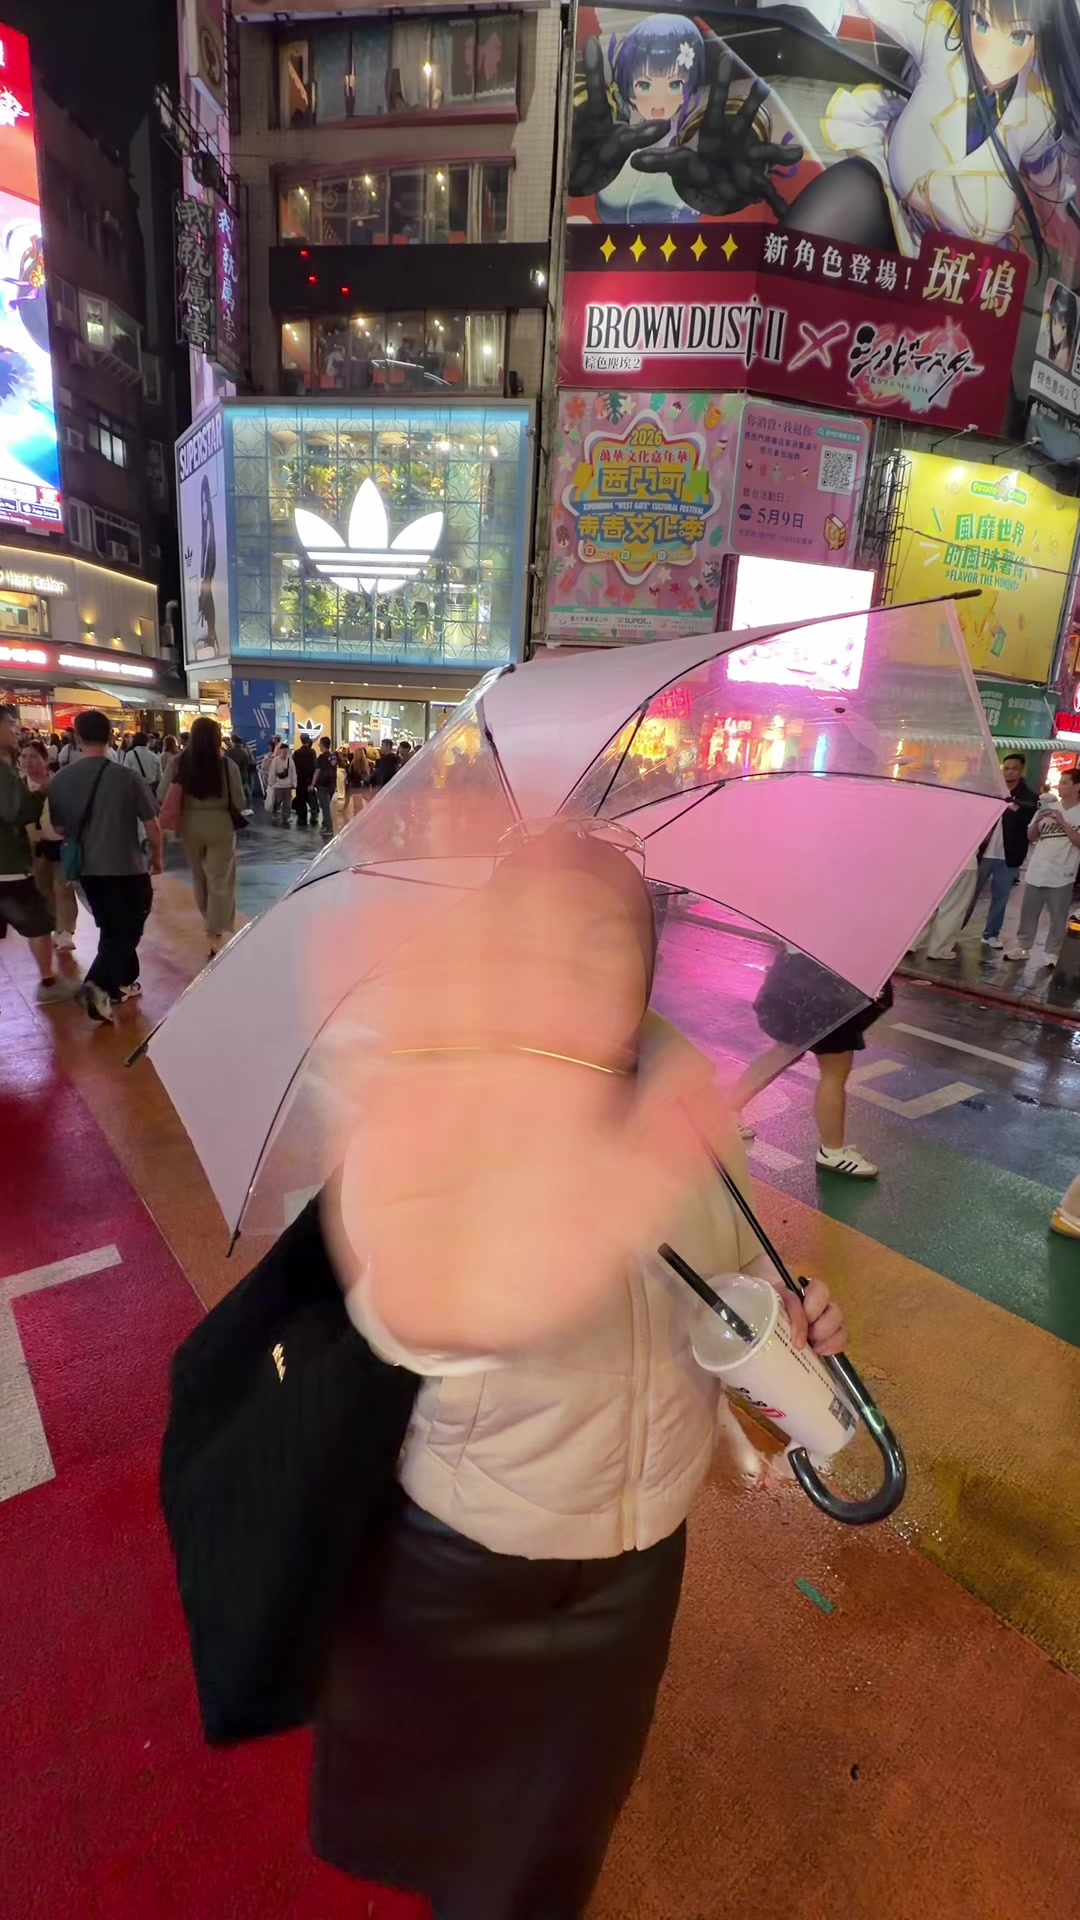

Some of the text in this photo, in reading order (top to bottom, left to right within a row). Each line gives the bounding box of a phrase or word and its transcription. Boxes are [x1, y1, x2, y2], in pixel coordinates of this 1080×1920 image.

[175, 200, 213, 344] 我就厲害
[217, 208, 238, 342] 我就厲害
[922, 246, 1017, 318] 斑鳩
[585, 296, 786, 367] BROWN DUST II
[179, 412, 223, 481] SUPERSTAR
[630, 429, 663, 446] 2026
[600, 449, 689, 464] 萬華文化嘉年華
[651, 502, 679, 511] CULTURAL
[679, 504, 704, 515] FESTIVAL
[756, 508, 804, 529] 5月9日
[577, 515, 706, 543] 青春文化季
[956, 513, 1025, 546] 風靡世界
[945, 543, 1027, 581] 的風味薯條
[980, 573, 993, 587] THE
